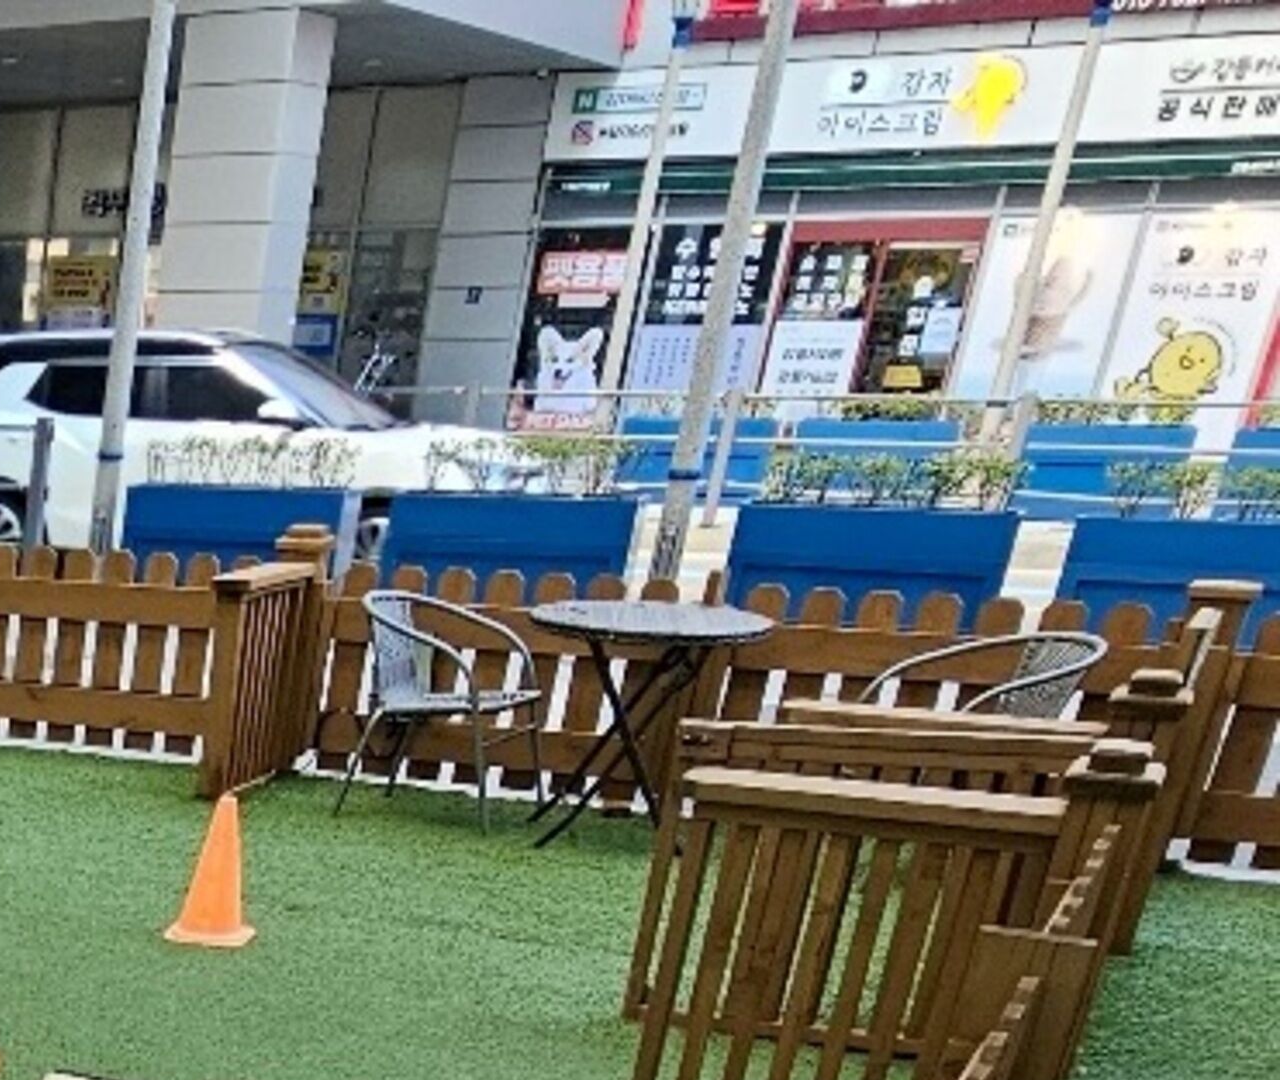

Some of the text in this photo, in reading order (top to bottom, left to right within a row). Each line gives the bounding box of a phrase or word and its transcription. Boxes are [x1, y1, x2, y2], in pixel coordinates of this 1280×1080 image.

[903, 66, 953, 98] 감자
[817, 106, 944, 137] 아이스크림
[1149, 279, 1261, 301] 아이스크림
